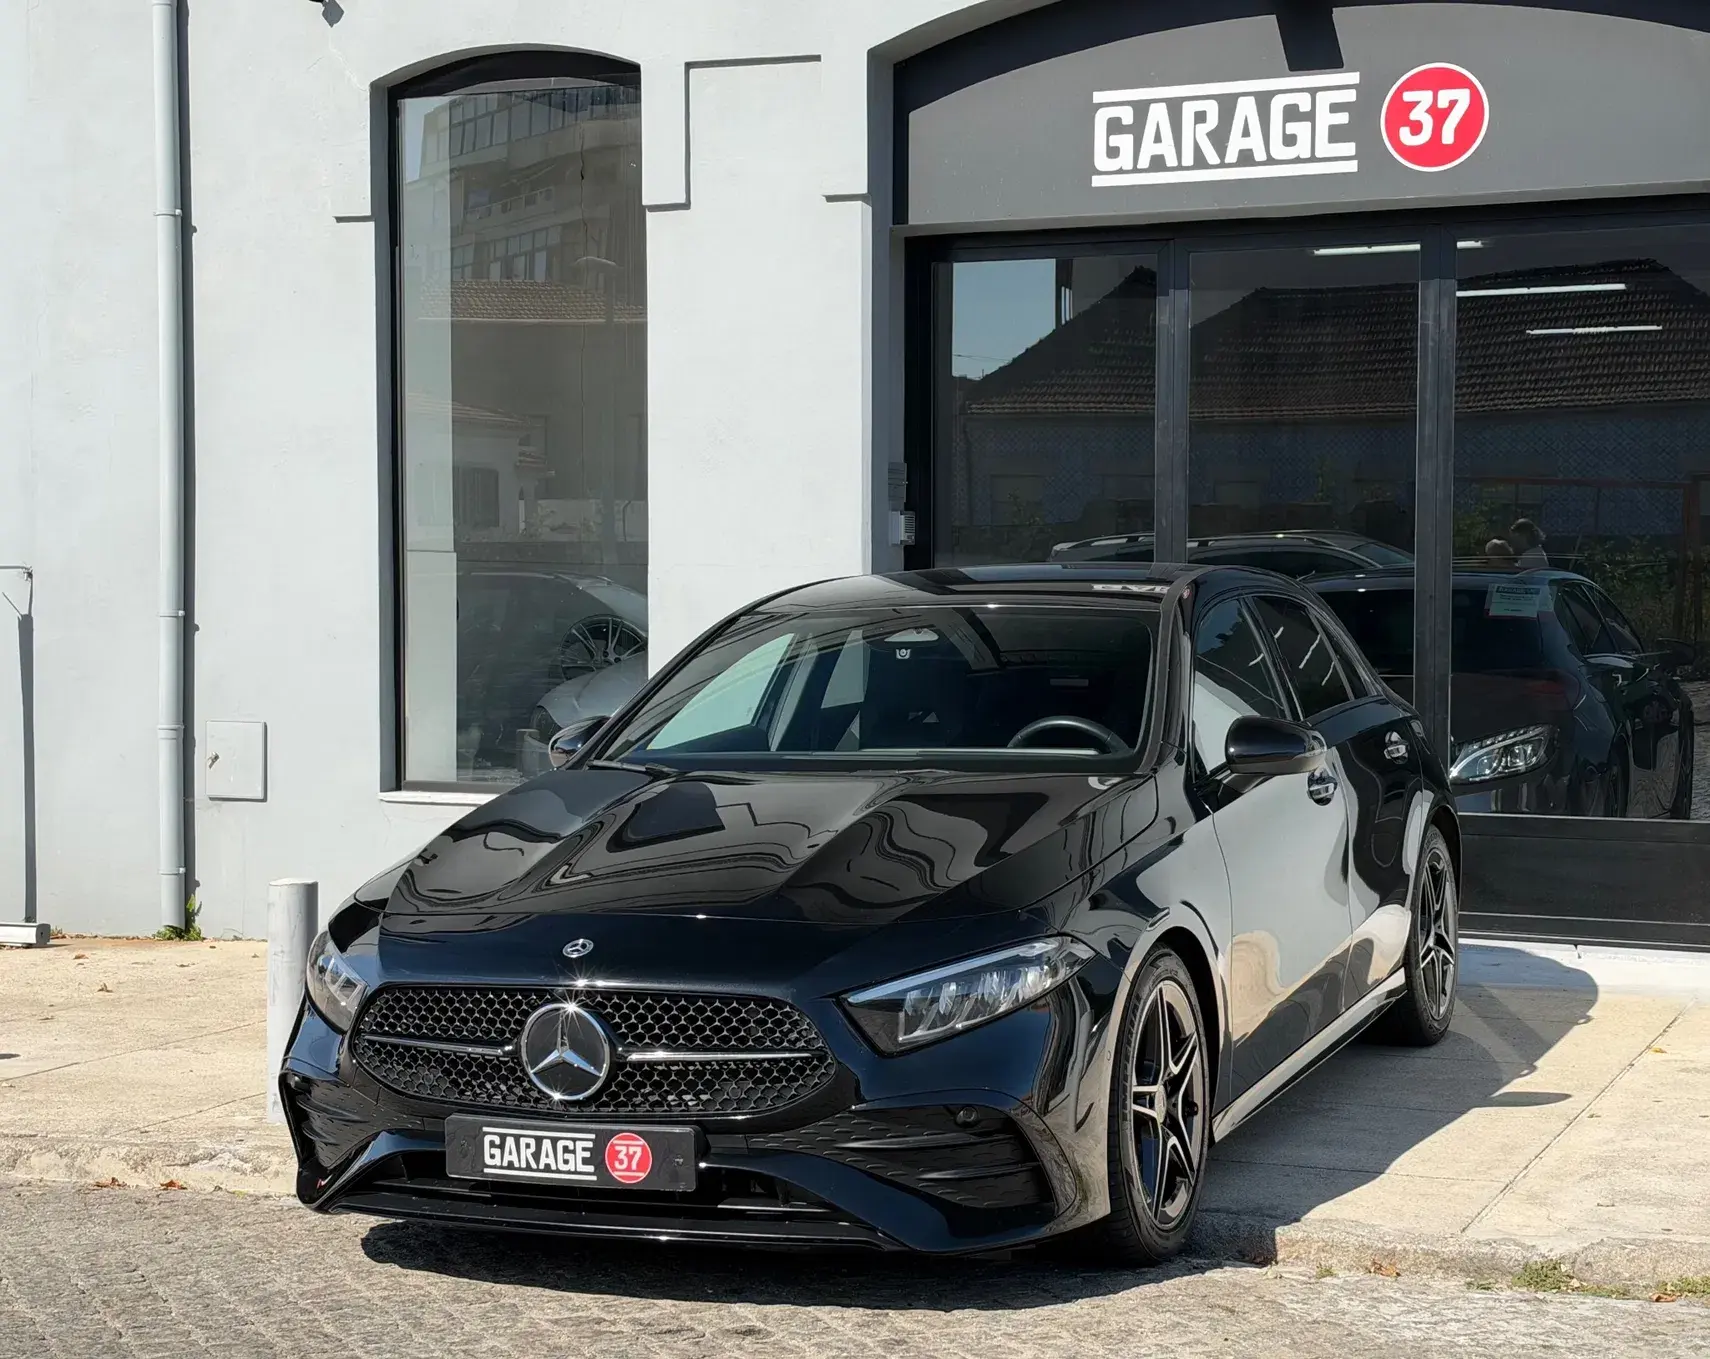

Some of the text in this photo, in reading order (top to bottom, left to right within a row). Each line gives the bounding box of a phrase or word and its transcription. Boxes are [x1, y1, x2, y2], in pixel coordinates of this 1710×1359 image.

[1094, 88, 1471, 172] GARAGE 37
[483, 1134, 643, 1172] GARAGE 37
